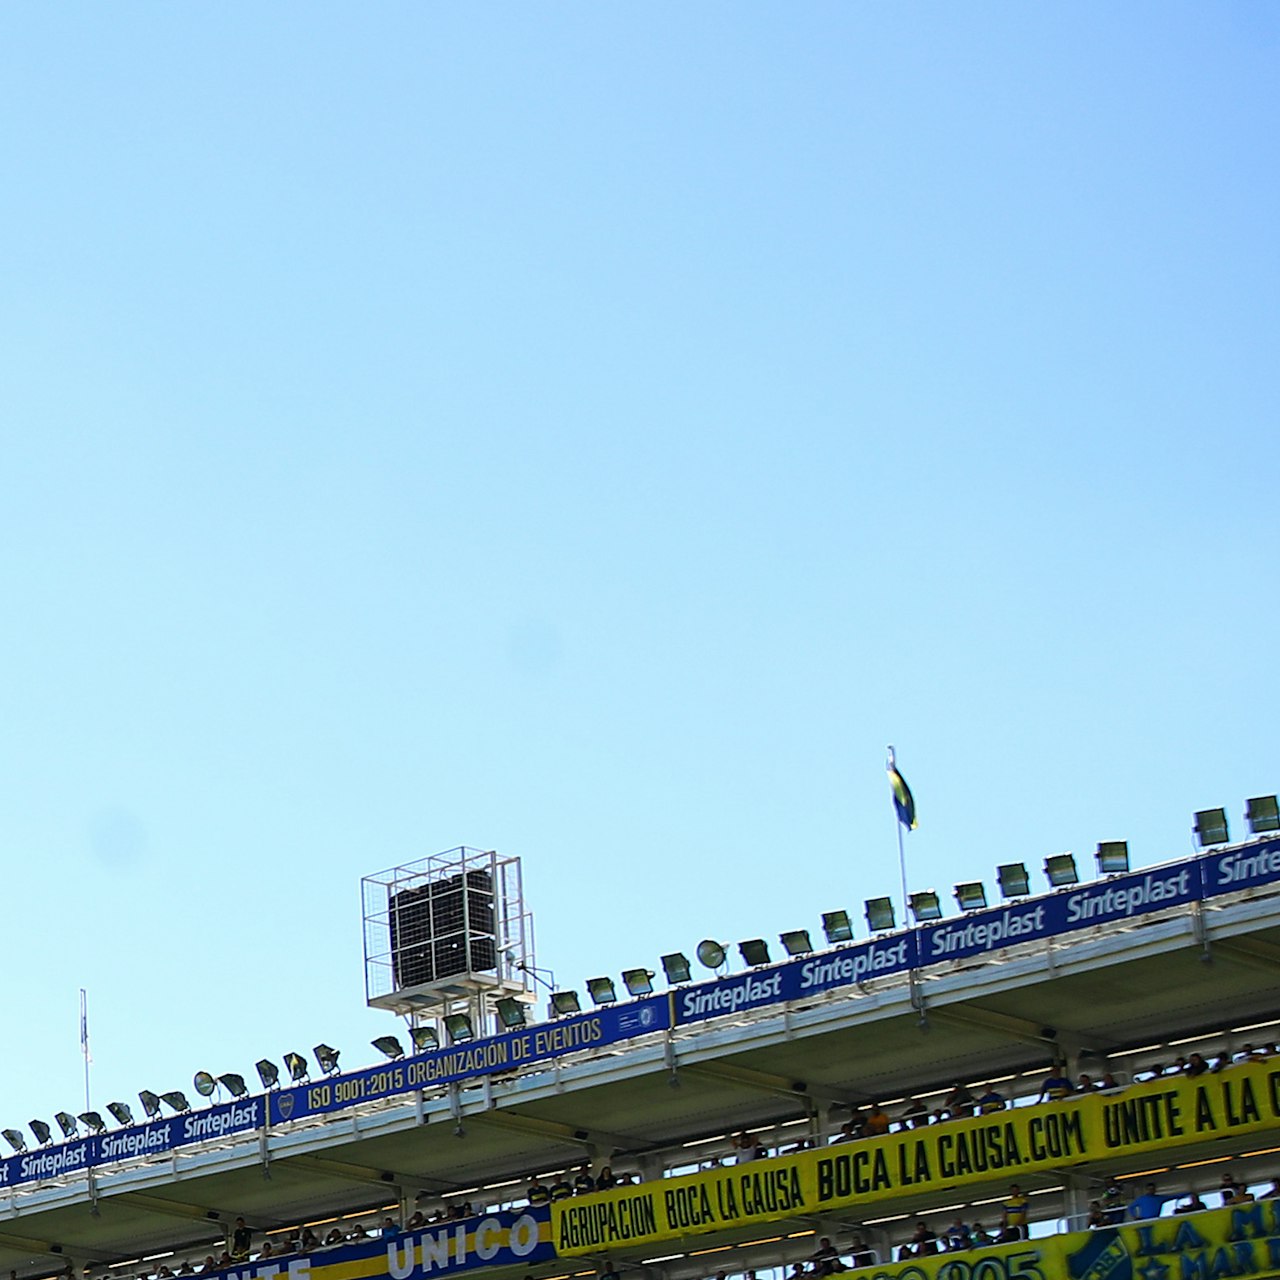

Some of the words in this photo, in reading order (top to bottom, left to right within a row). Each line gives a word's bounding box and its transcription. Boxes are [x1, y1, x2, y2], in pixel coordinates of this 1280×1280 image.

[1067, 870, 1190, 924] Sinteplast
[931, 905, 1044, 956] Sinteplast
[800, 940, 908, 989] Sinteplast
[683, 972, 783, 1018] Sinteplast
[308, 1081, 331, 1110] ISO
[335, 1069, 404, 1104] 9001:2015
[407, 1038, 508, 1085] ORGANIZACIÓN
[512, 1034, 531, 1059] DE
[536, 1017, 602, 1056] EVENTOS
[100, 1124, 171, 1157] Sinteplast
[184, 1102, 258, 1138] Sinteplast
[1103, 1088, 1184, 1150] UNITE
[1196, 1084, 1217, 1132] A
[1222, 1080, 1261, 1128] LA
[20, 1143, 86, 1177] Sinteplast
[817, 1146, 891, 1201] BOCA
[899, 1138, 933, 1186] LA
[938, 1110, 1087, 1180] CAUSA.COM
[560, 1190, 657, 1251] AGRUPACION
[665, 1183, 714, 1230] BOCA
[716, 1181, 737, 1221] LA
[740, 1165, 805, 1214] CAUSA
[386, 1213, 540, 1280] UNICO
[1137, 1220, 1209, 1257] LA
